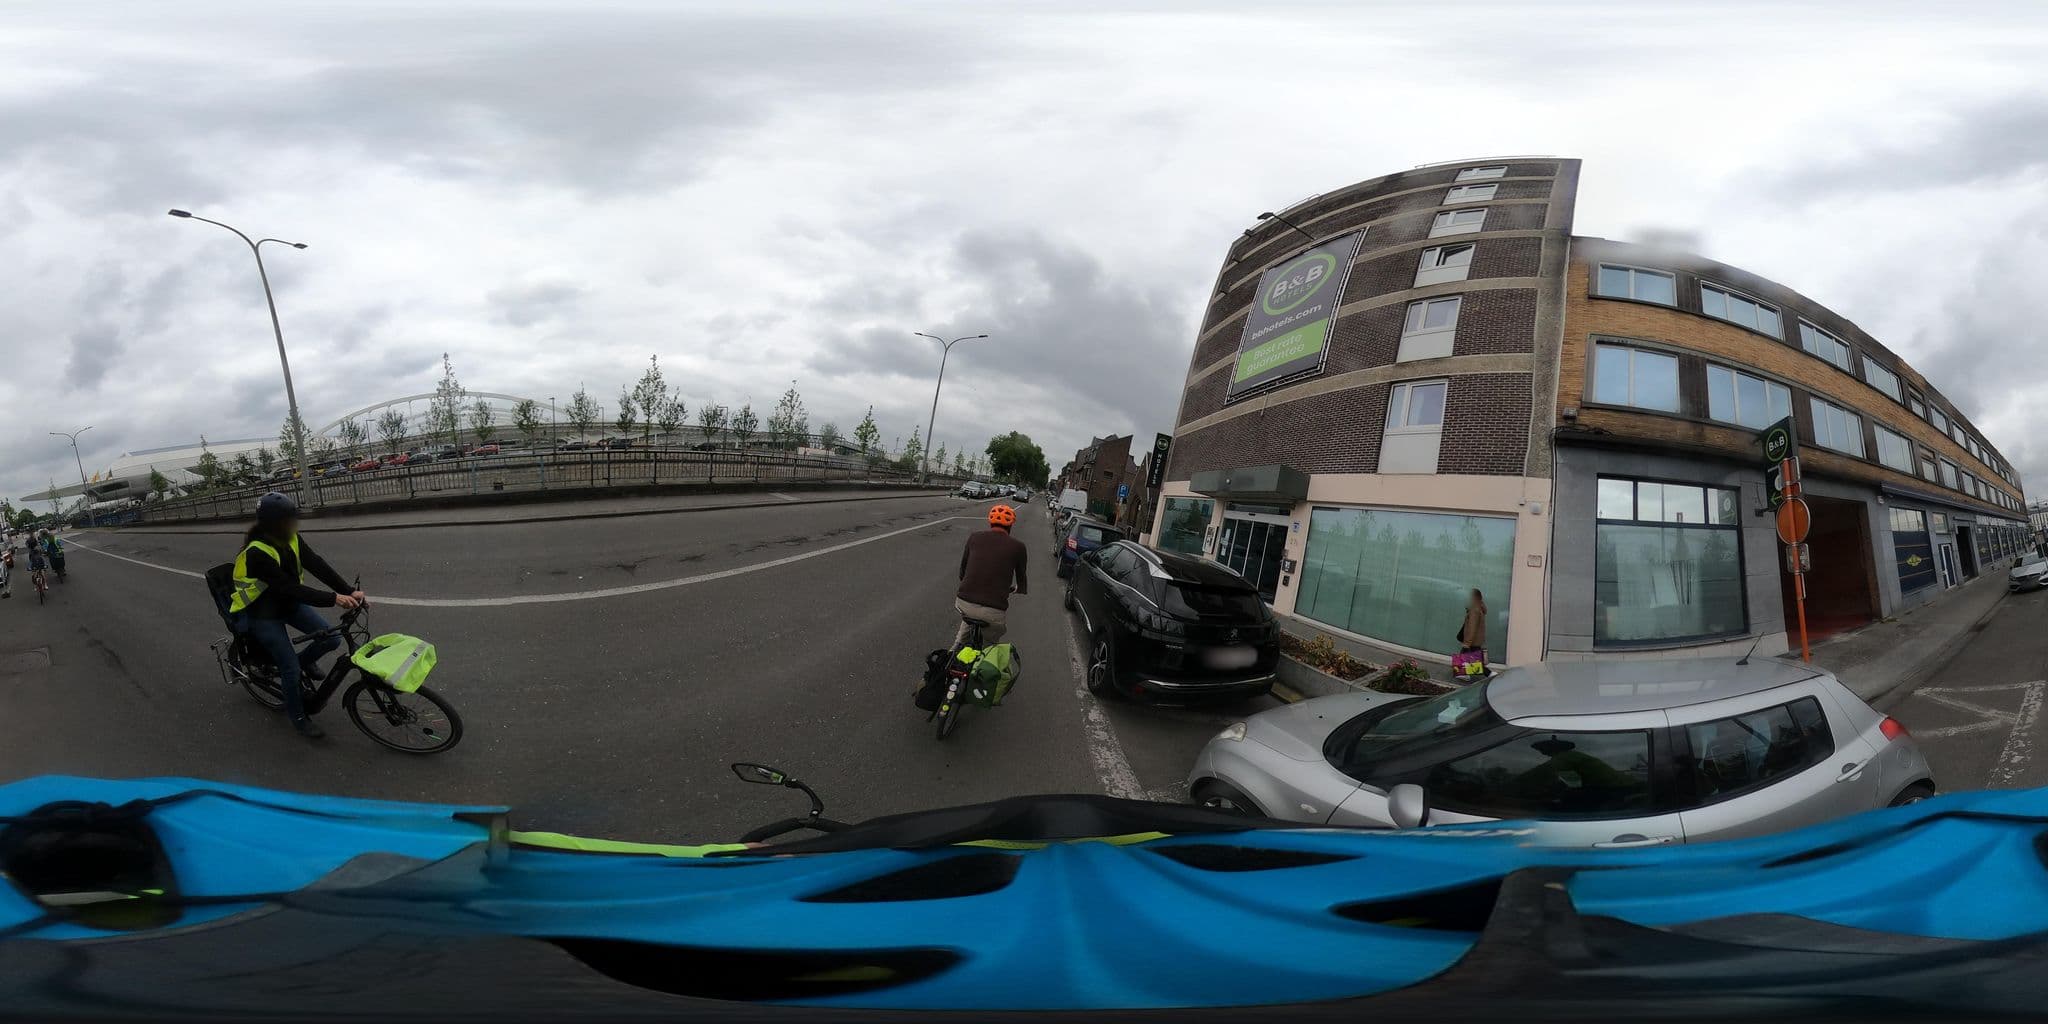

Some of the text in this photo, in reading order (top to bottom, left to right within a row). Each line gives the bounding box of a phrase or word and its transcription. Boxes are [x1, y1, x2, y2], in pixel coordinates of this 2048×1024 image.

[1272, 264, 1323, 300] B&B
[1251, 304, 1322, 340] bbhotels.com
[1769, 436, 1785, 452] B&B
